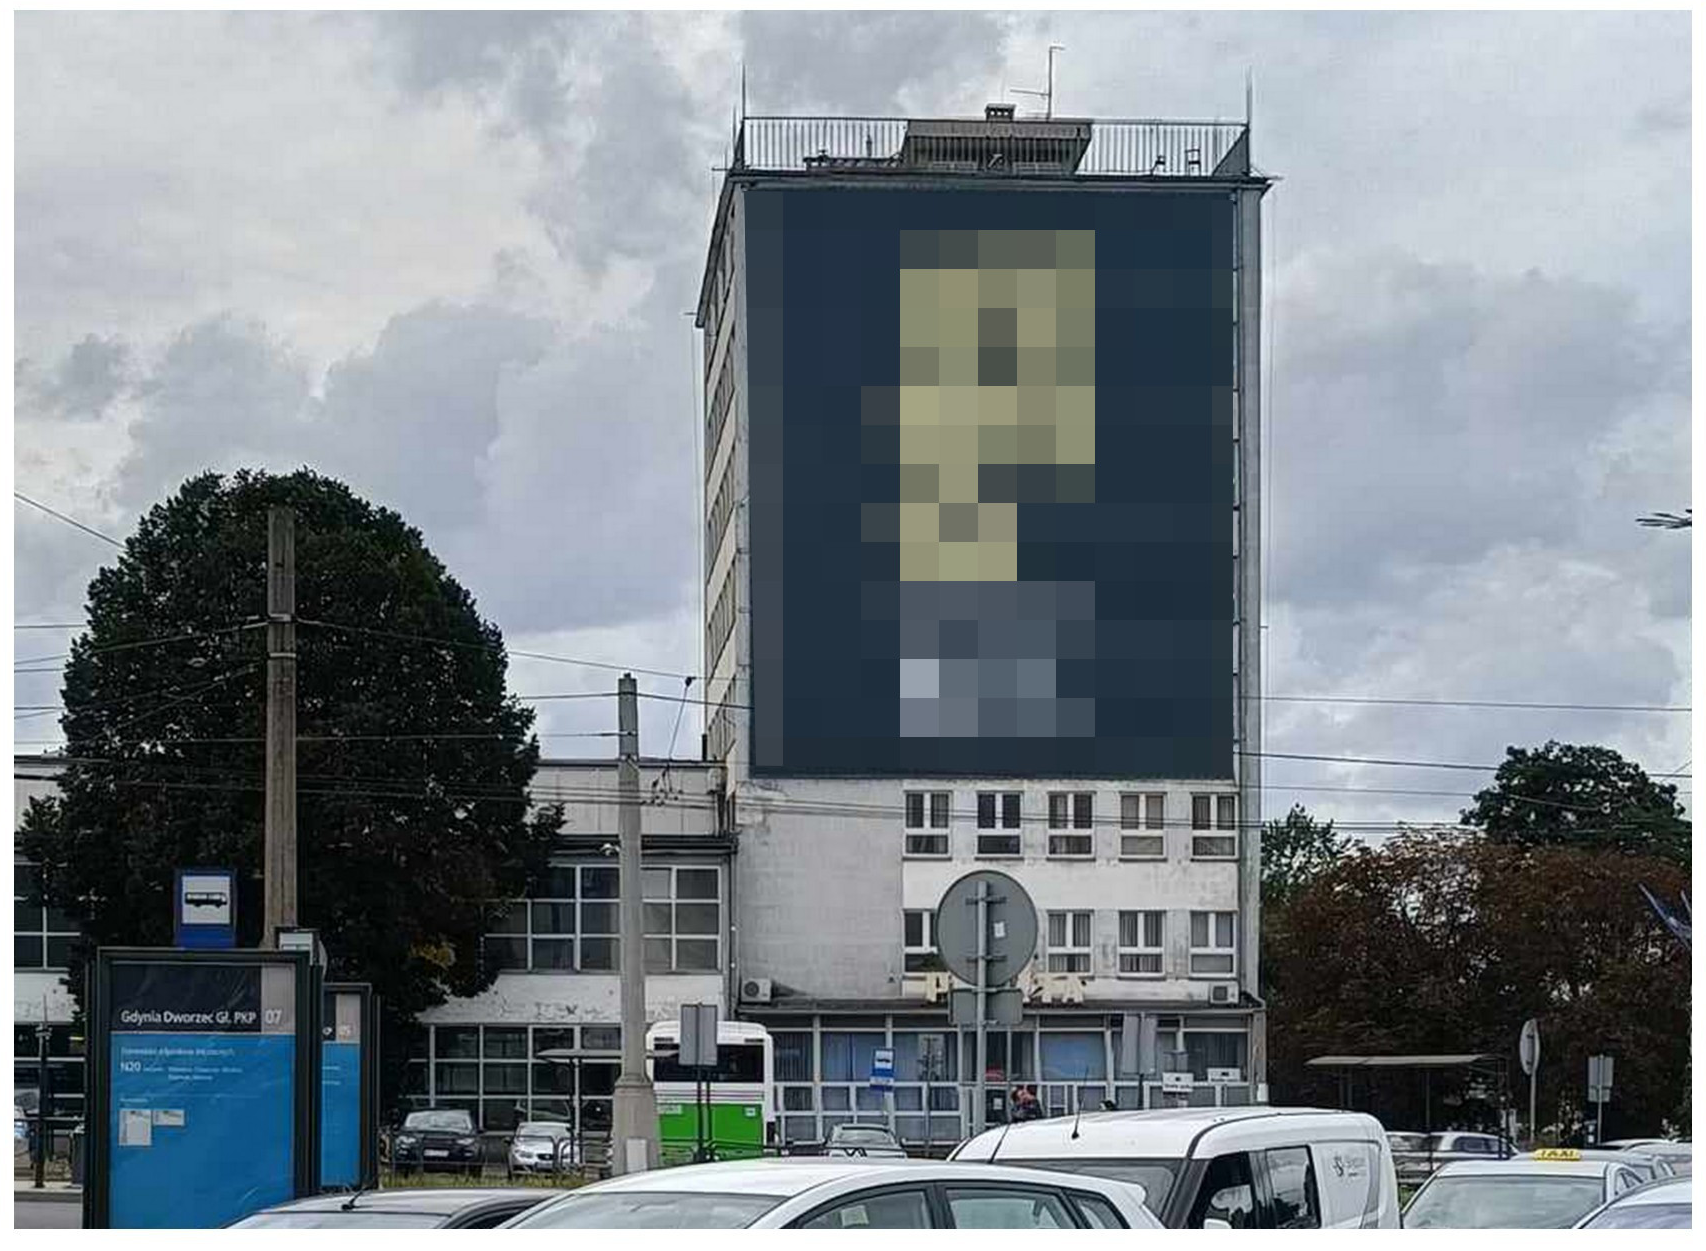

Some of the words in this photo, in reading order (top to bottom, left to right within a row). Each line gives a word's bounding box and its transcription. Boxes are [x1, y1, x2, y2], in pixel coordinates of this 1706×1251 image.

[121, 1010, 161, 1025] Gdynia
[163, 1010, 213, 1023] Dworzec
[233, 1012, 257, 1023] PKP
[265, 1010, 281, 1024] 07
